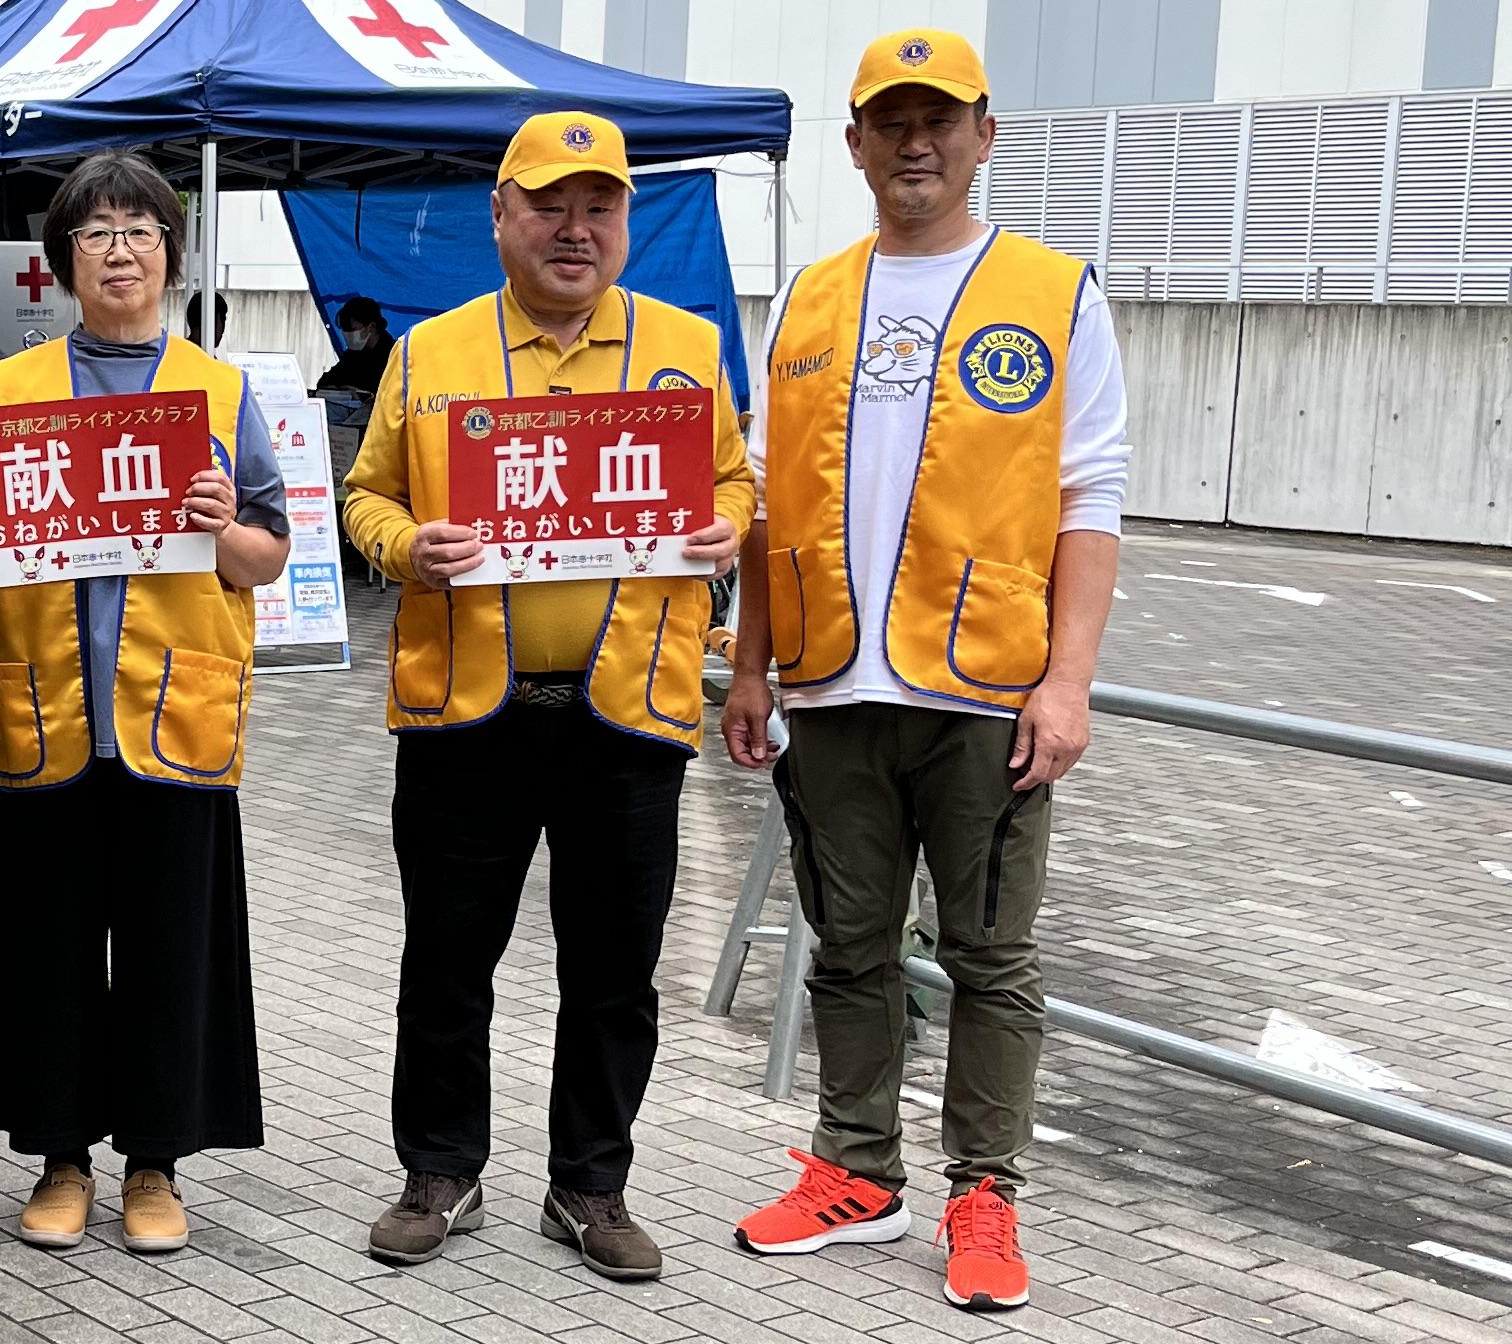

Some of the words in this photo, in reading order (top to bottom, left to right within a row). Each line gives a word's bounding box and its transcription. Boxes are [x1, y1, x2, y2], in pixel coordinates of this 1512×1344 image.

[987, 333, 1034, 353] LIONS
[776, 347, 834, 383] Y.YAMAMOTO
[995, 351, 1018, 380] L
[0, 405, 199, 438] 京都乙訓ライオンズクラブ
[497, 402, 705, 432] 京都乙訓ライオンズクラブ
[0, 432, 171, 516] 献血
[493, 431, 669, 512] 献血
[471, 507, 693, 542] おねがいします
